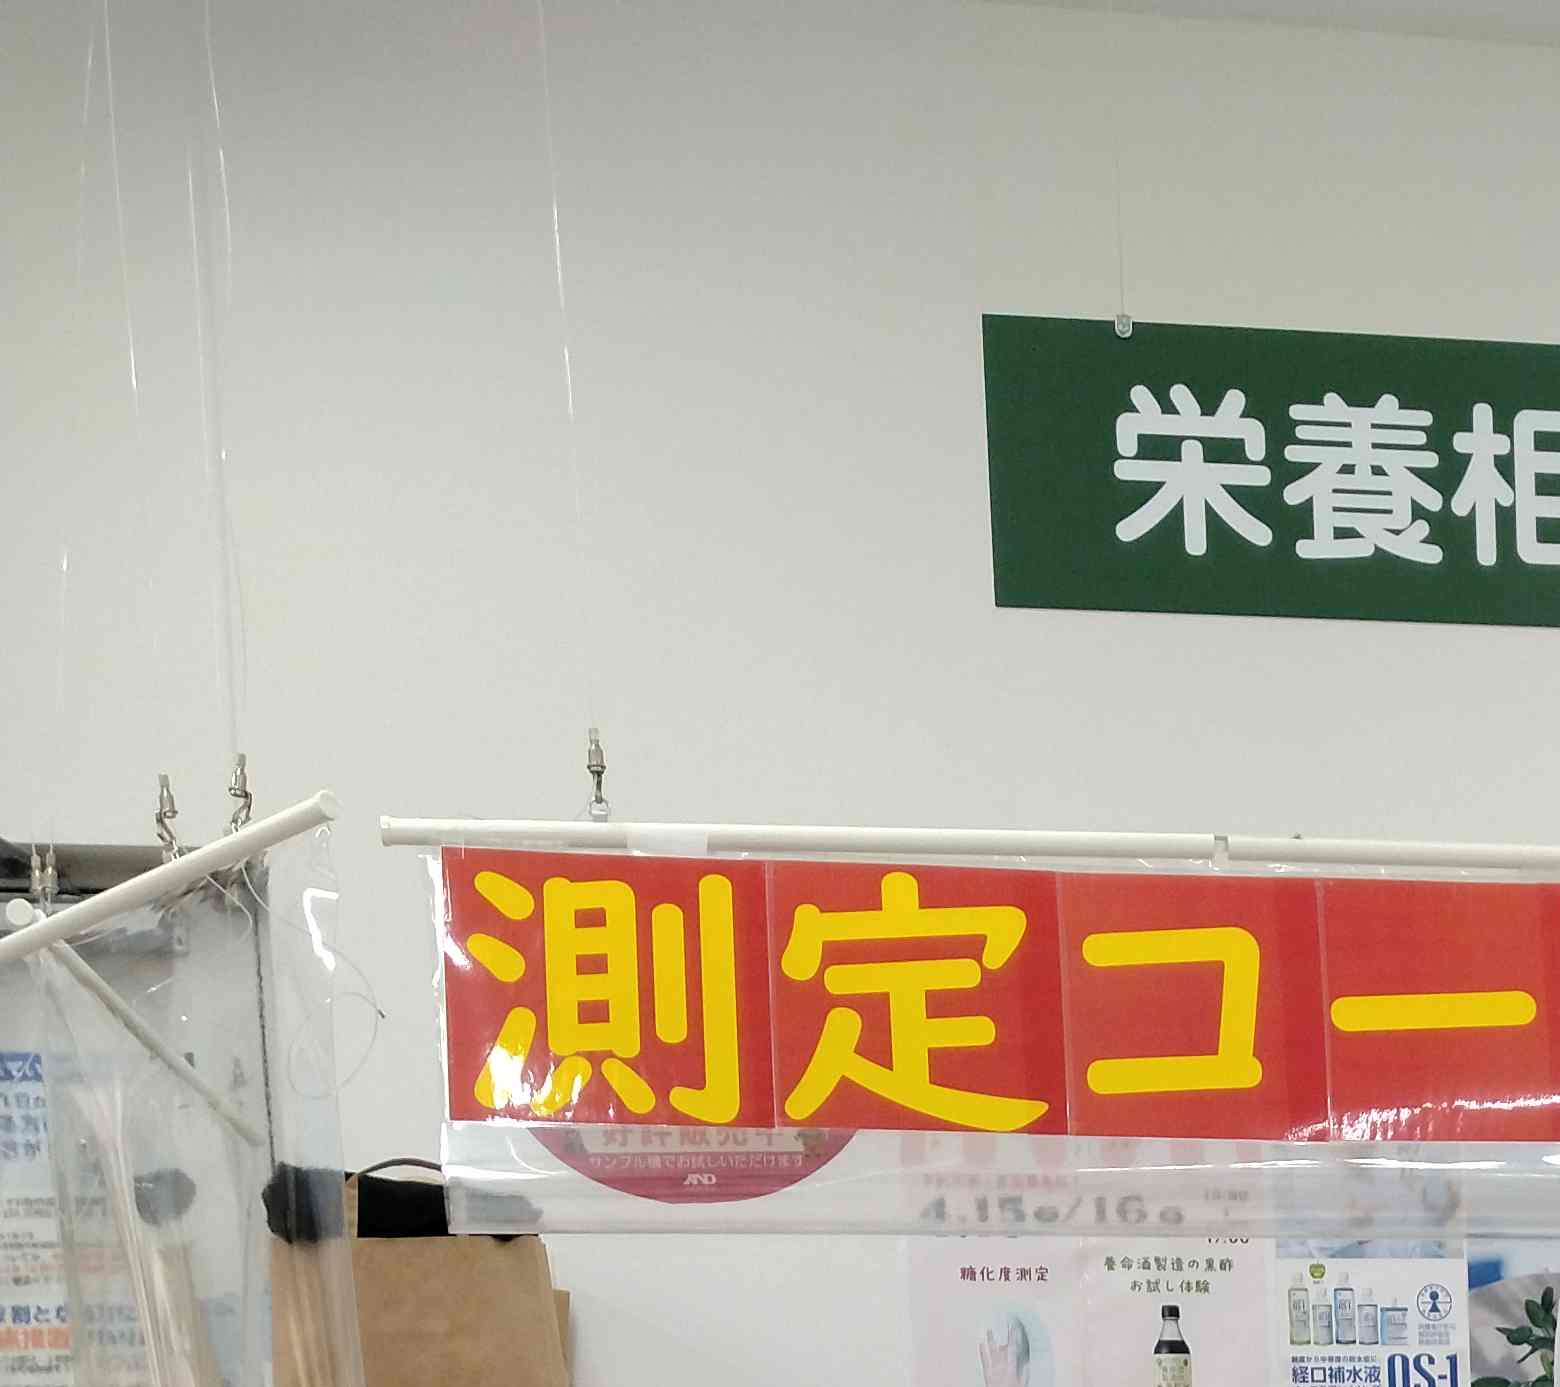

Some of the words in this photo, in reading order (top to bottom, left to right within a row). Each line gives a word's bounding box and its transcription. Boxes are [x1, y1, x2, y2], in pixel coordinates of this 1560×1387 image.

[1104, 1256, 1235, 1272] 養命酒製造の黒酢
[959, 1265, 1050, 1282] 糖化度測定
[1130, 1279, 1212, 1295] お試し体験
[1291, 1366, 1382, 1384] 経口補水液
